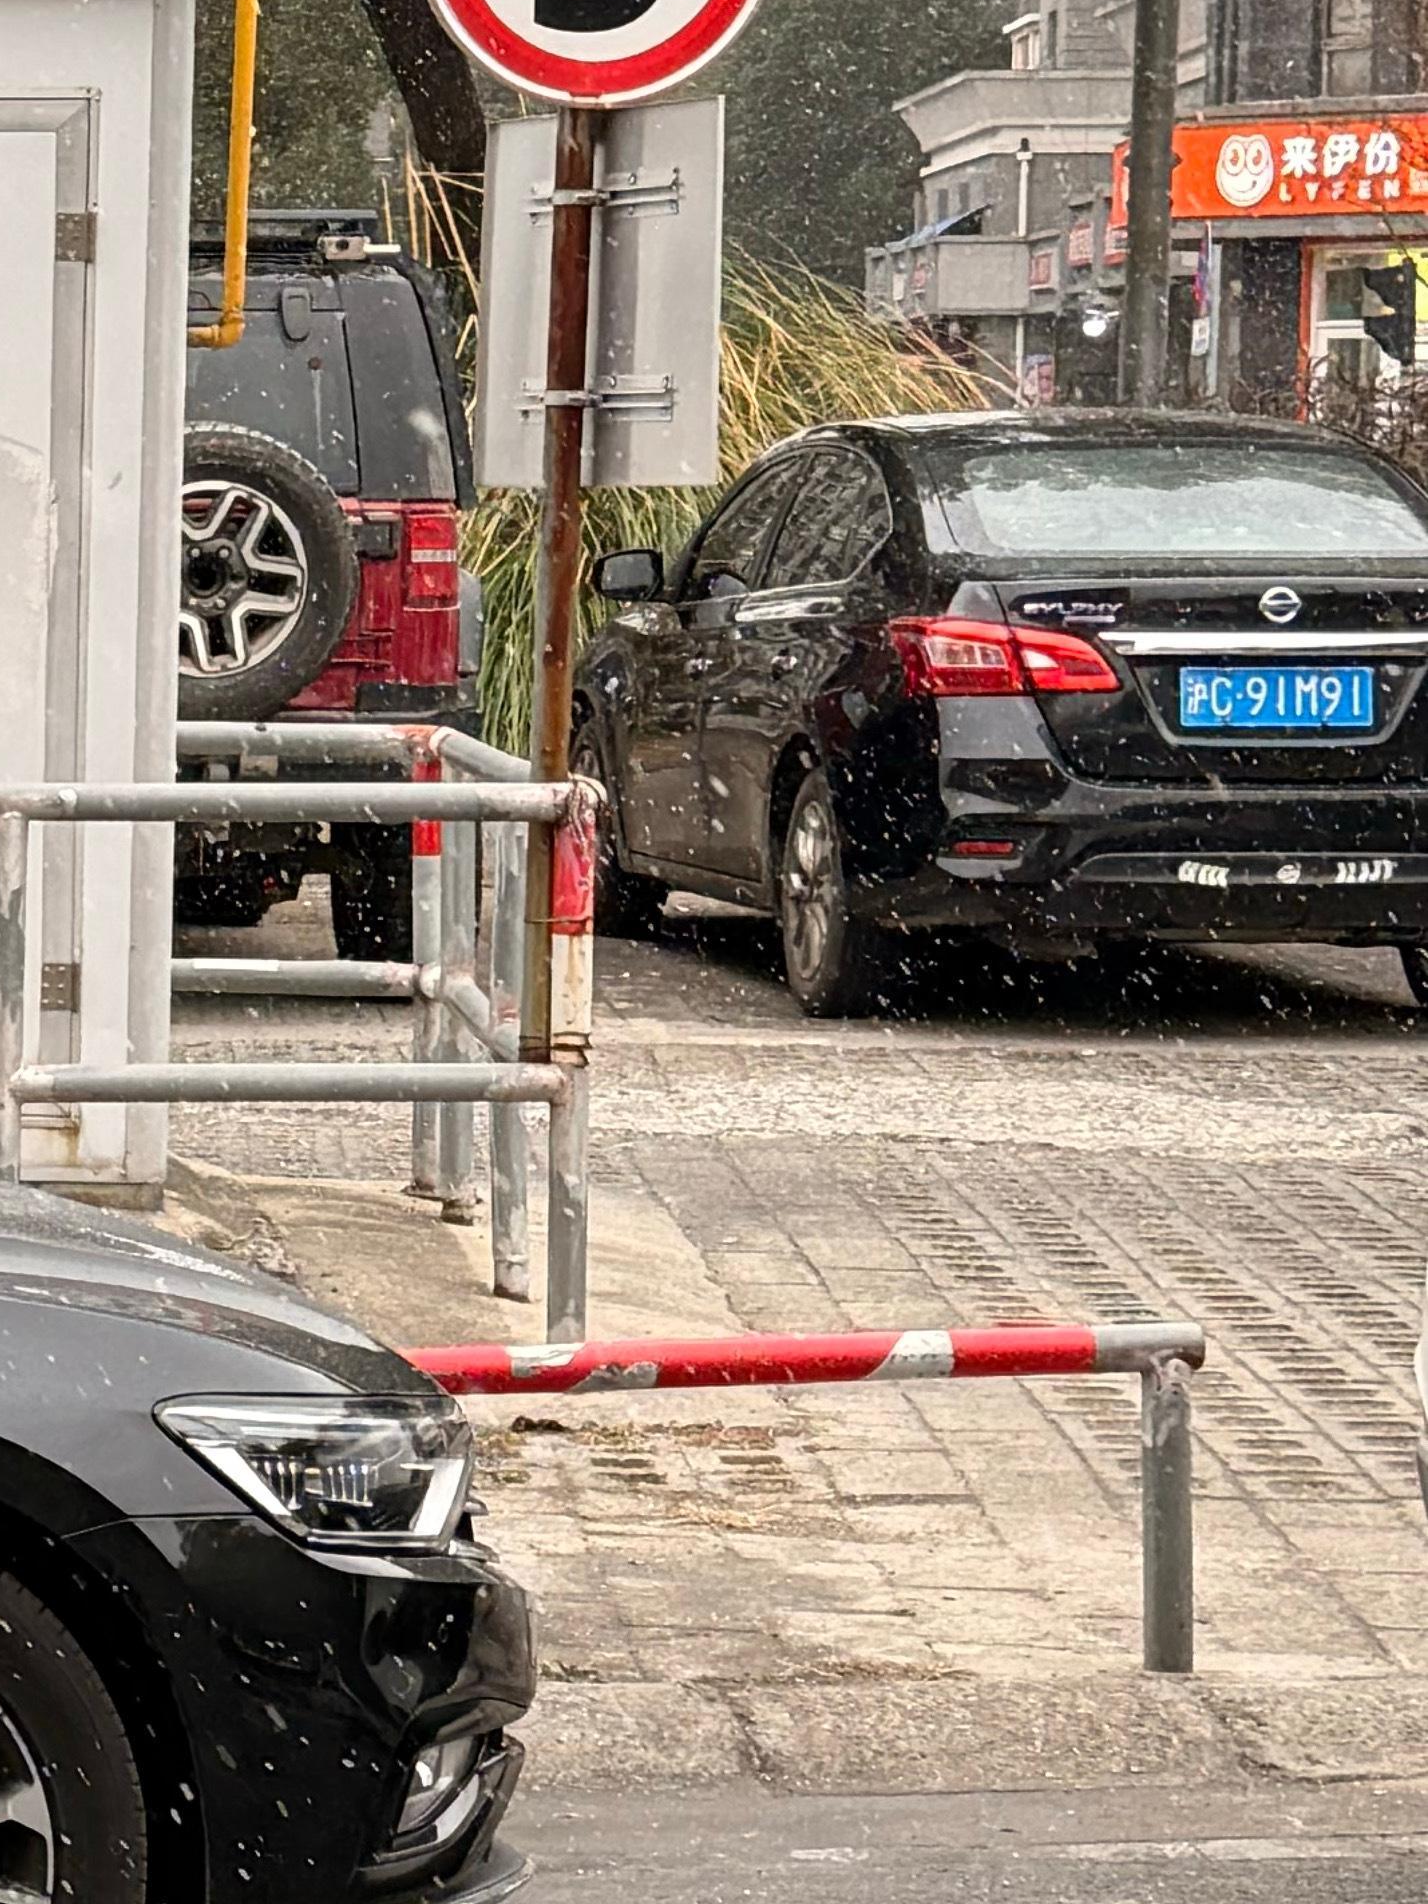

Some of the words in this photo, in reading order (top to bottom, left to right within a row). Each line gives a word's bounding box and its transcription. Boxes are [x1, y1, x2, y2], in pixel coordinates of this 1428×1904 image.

[1280, 131, 1402, 178] 来伊份
[1279, 179, 1401, 202] LYFEN
